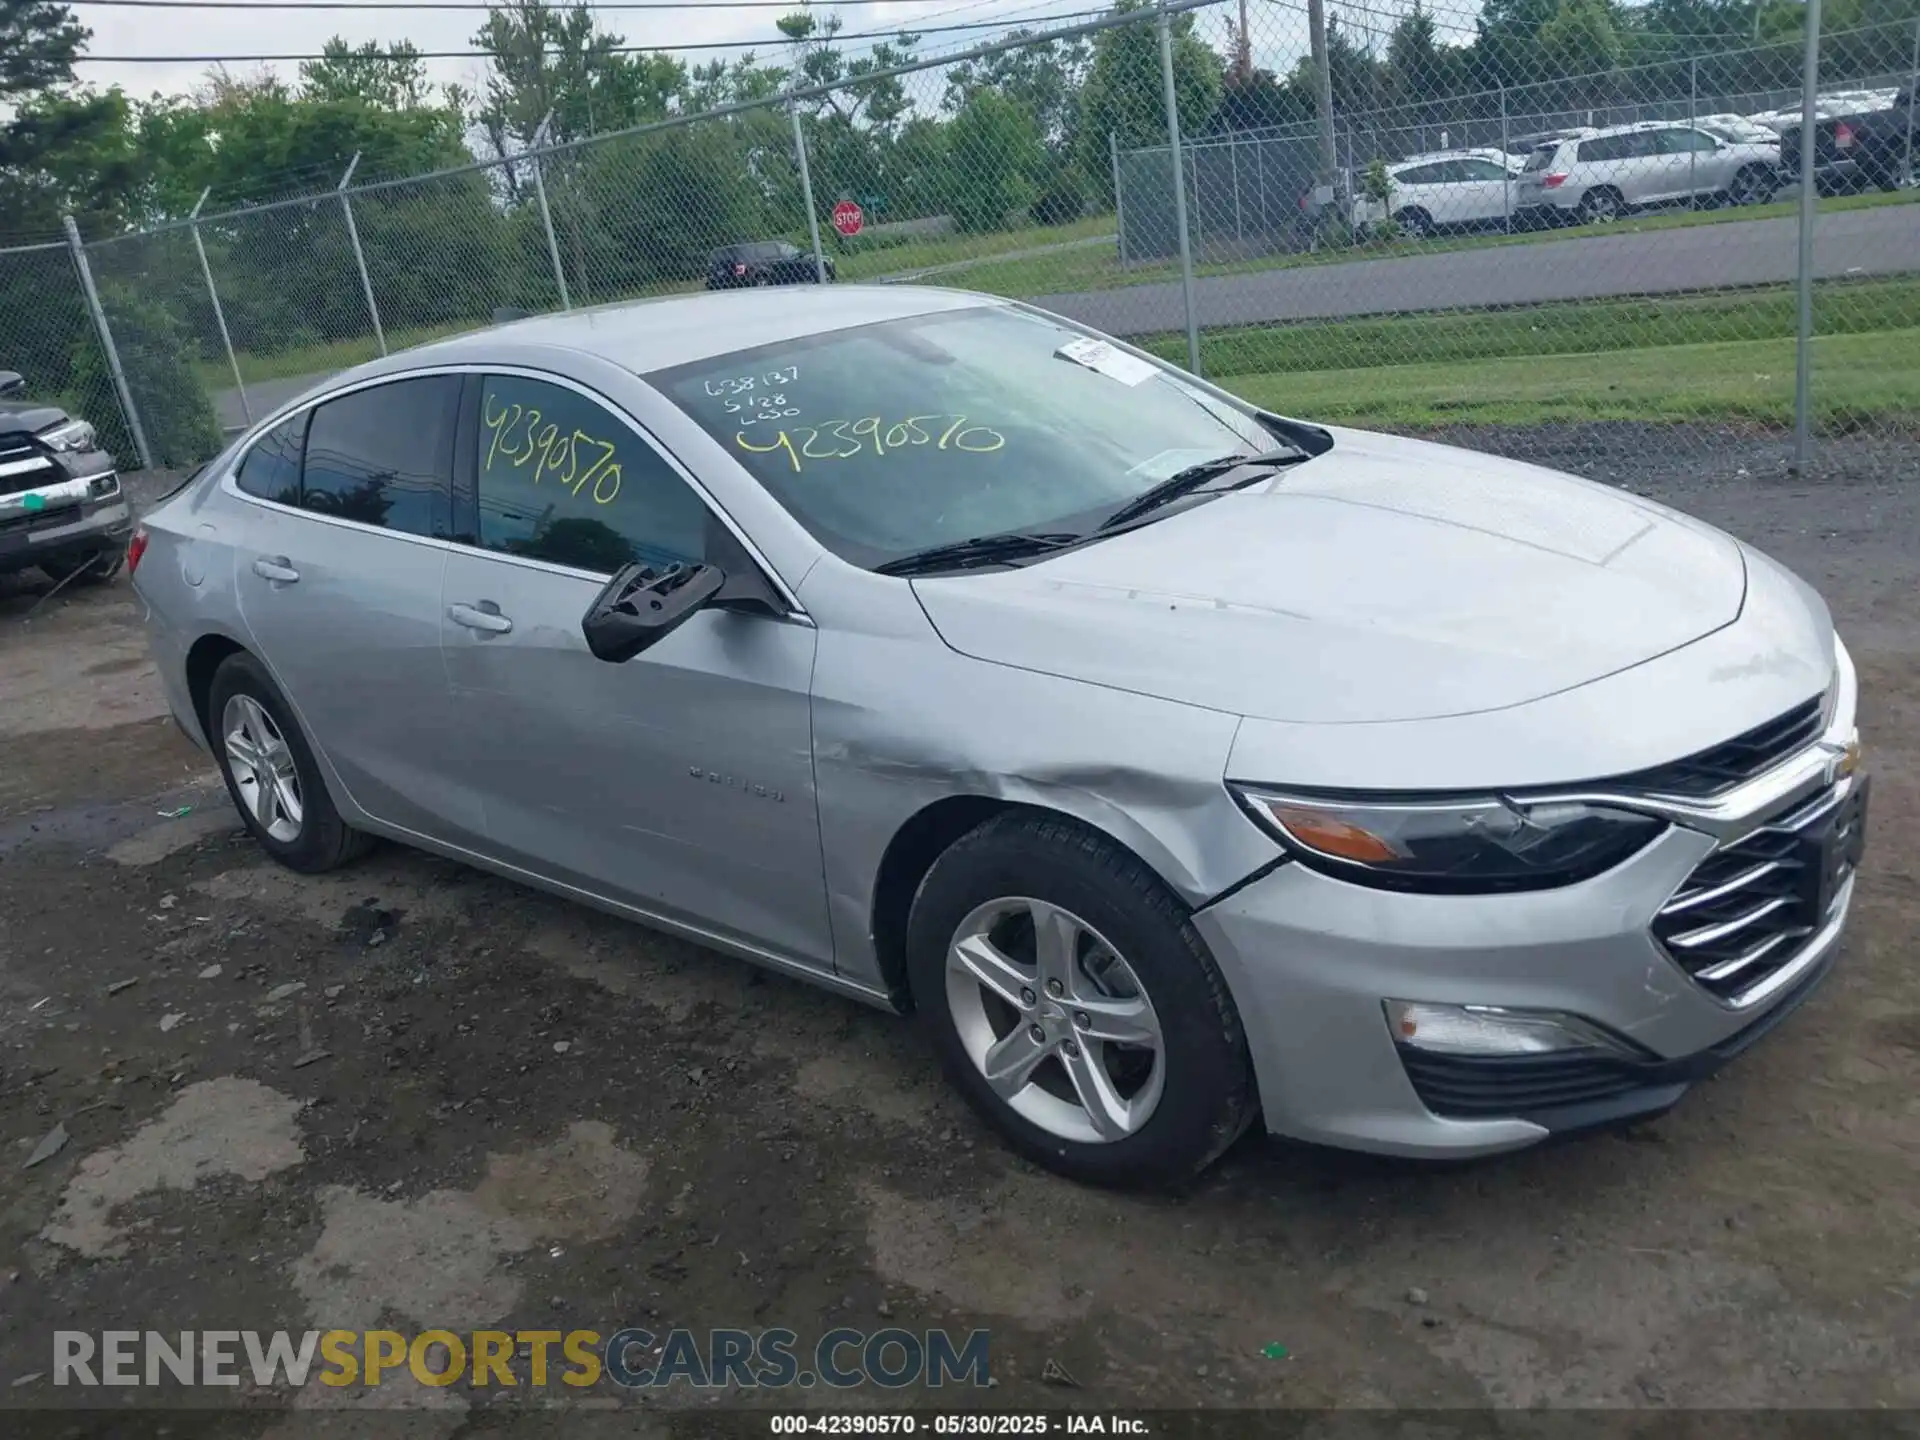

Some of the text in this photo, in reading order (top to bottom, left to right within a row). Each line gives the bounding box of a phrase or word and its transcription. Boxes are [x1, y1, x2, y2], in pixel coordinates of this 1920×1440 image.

[835, 211, 861, 226] STOP
[485, 393, 623, 504] 42390570
[736, 414, 1006, 473] 42390570
